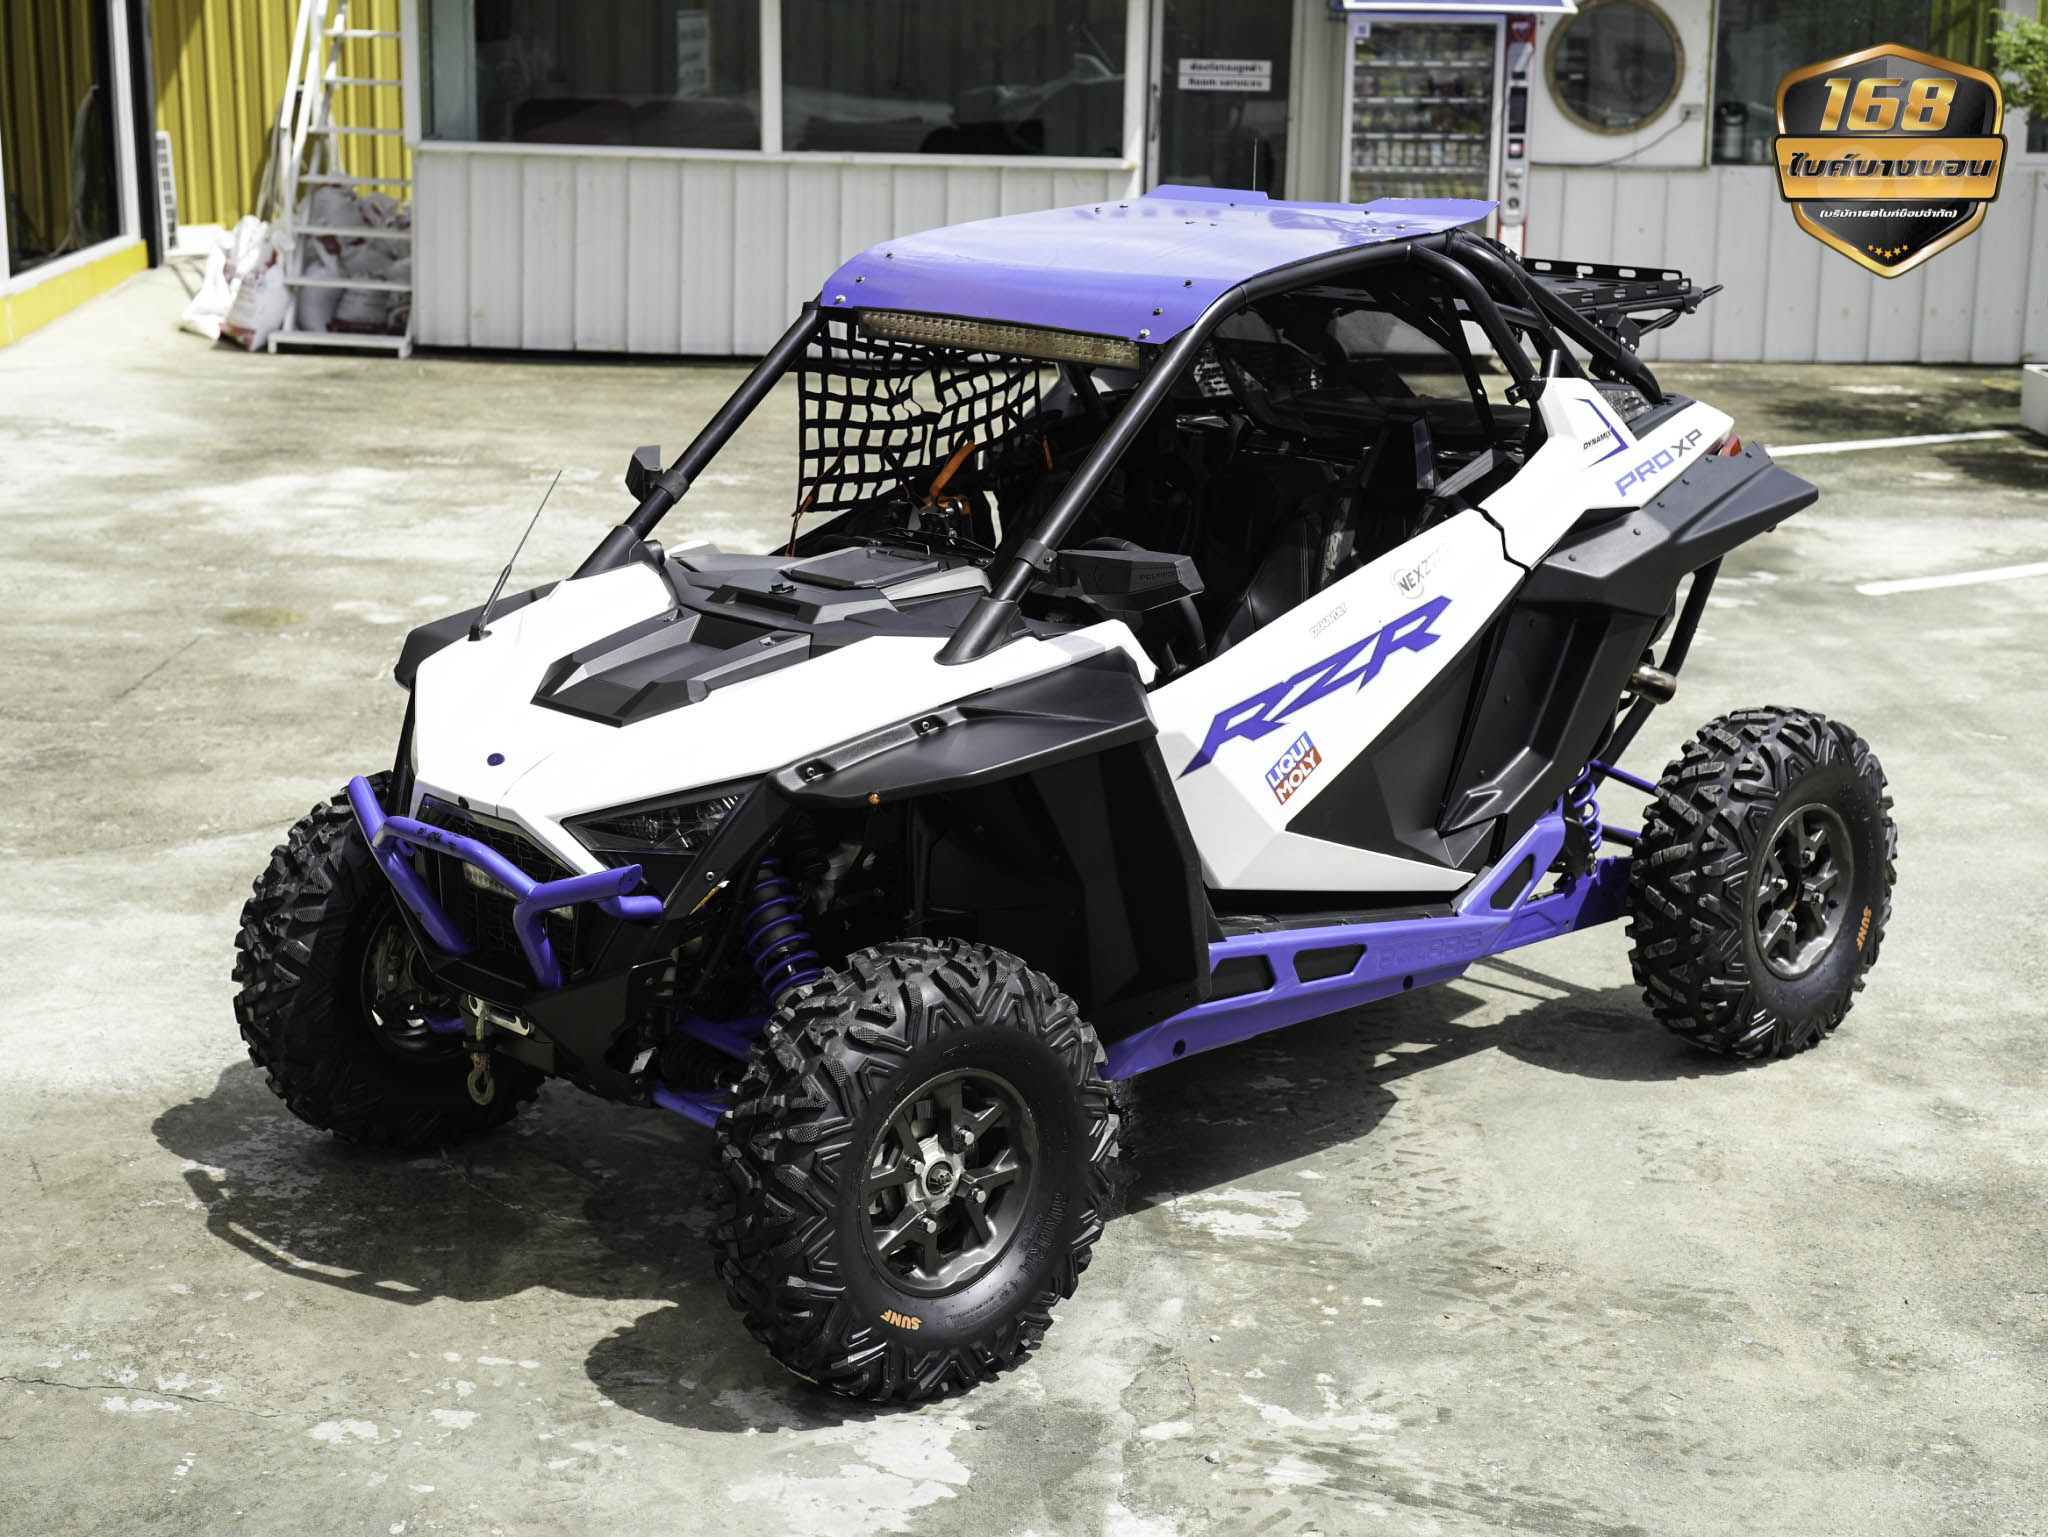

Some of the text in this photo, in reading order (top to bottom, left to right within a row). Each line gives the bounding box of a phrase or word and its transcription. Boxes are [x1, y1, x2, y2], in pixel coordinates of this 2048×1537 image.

[1615, 428, 1703, 497] PRO XP
[1176, 595, 1453, 780] RZR
[1265, 732, 1312, 790] LIQUI
[1274, 747, 1319, 804] MOLY
[1856, 904, 1872, 953] SUNF
[880, 1308, 923, 1331] SUNF
